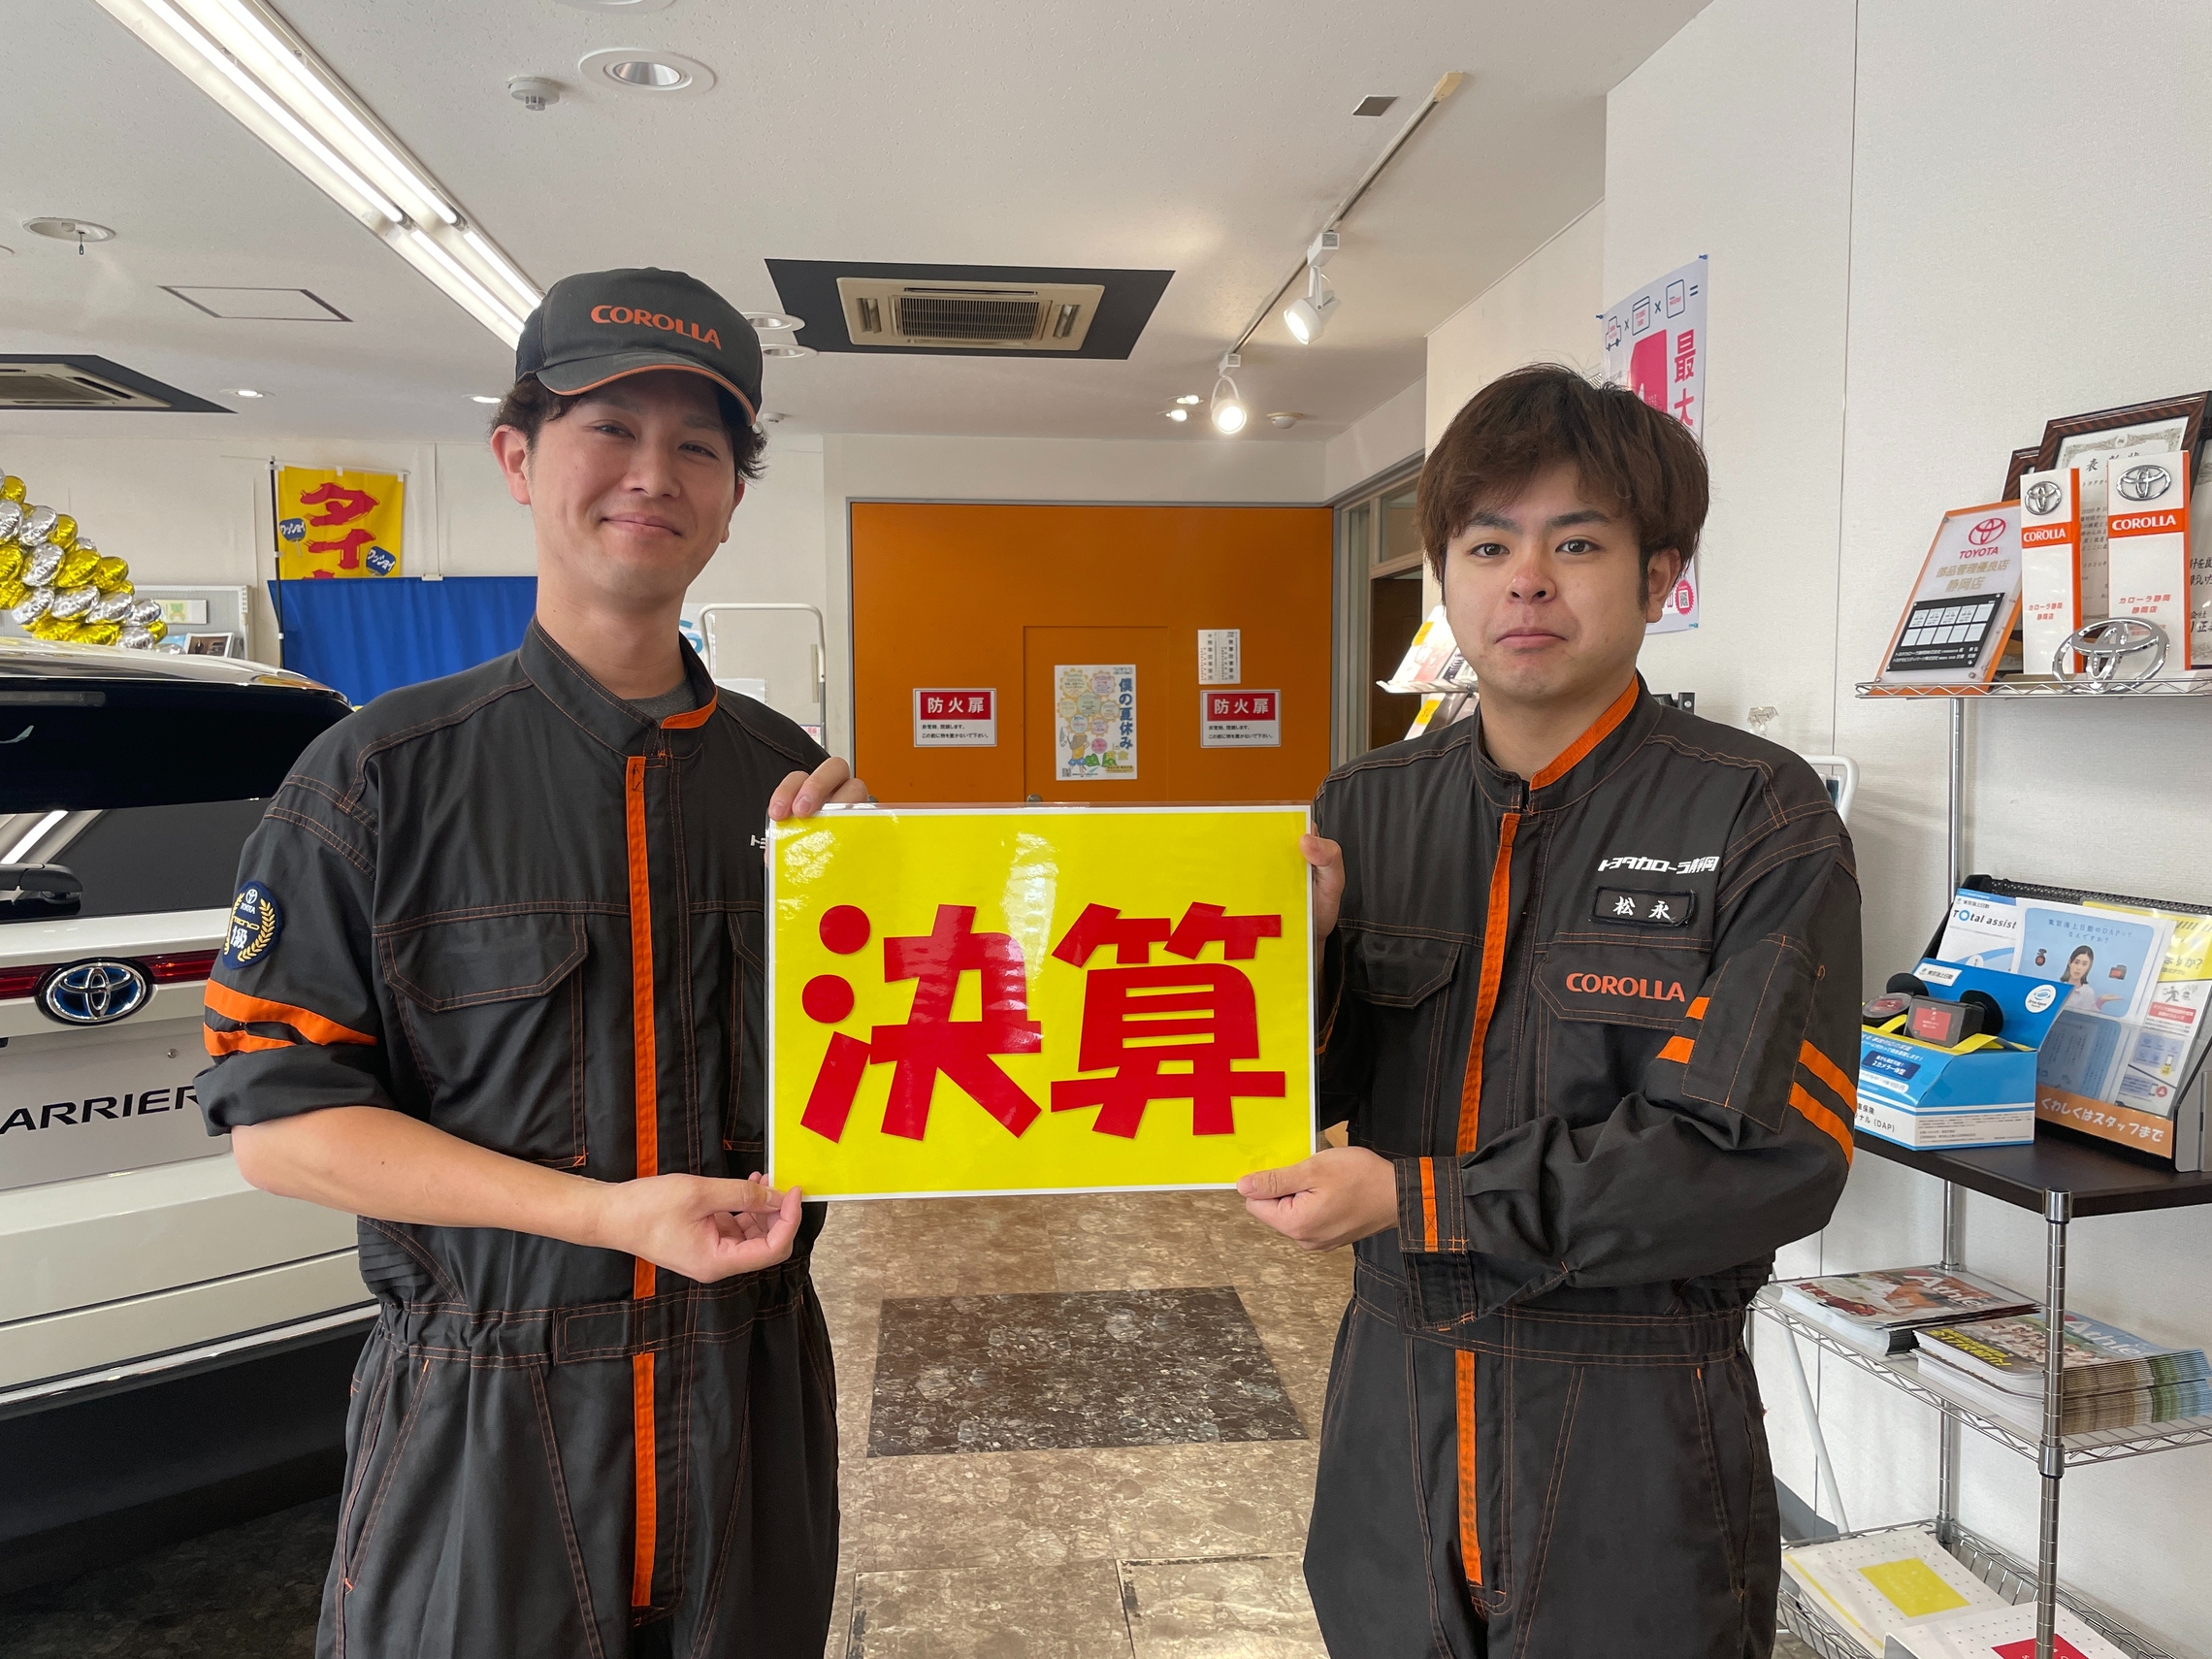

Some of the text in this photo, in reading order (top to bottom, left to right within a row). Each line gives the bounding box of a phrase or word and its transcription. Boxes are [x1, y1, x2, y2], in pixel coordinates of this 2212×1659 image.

[590, 305, 722, 350] COROLLA
[300, 482, 379, 579] タイ
[2111, 514, 2177, 532] COROLLA
[2023, 527, 2066, 543] COROLLA
[1959, 546, 2000, 560] TOYOTA
[1945, 576, 1986, 593] 静岡店
[2028, 602, 2063, 611] カローラ静岡
[2119, 594, 2171, 604] カローラ静岡
[2036, 612, 2054, 621] 静岡店
[2131, 605, 2158, 614] 静岡店
[927, 697, 985, 714] 防火扉
[1119, 677, 1134, 751] 僕の夏休み
[1214, 698, 1269, 715] 防火扉
[1597, 856, 1720, 875] トヨタカローラ静岡
[1612, 895, 1674, 921] 松永
[1986, 918, 2017, 929] assist
[1565, 972, 1685, 1002] COROLLA
[800, 901, 1285, 1144] 決算
[2041, 1097, 2164, 1143] くわしくはスタッフまで
